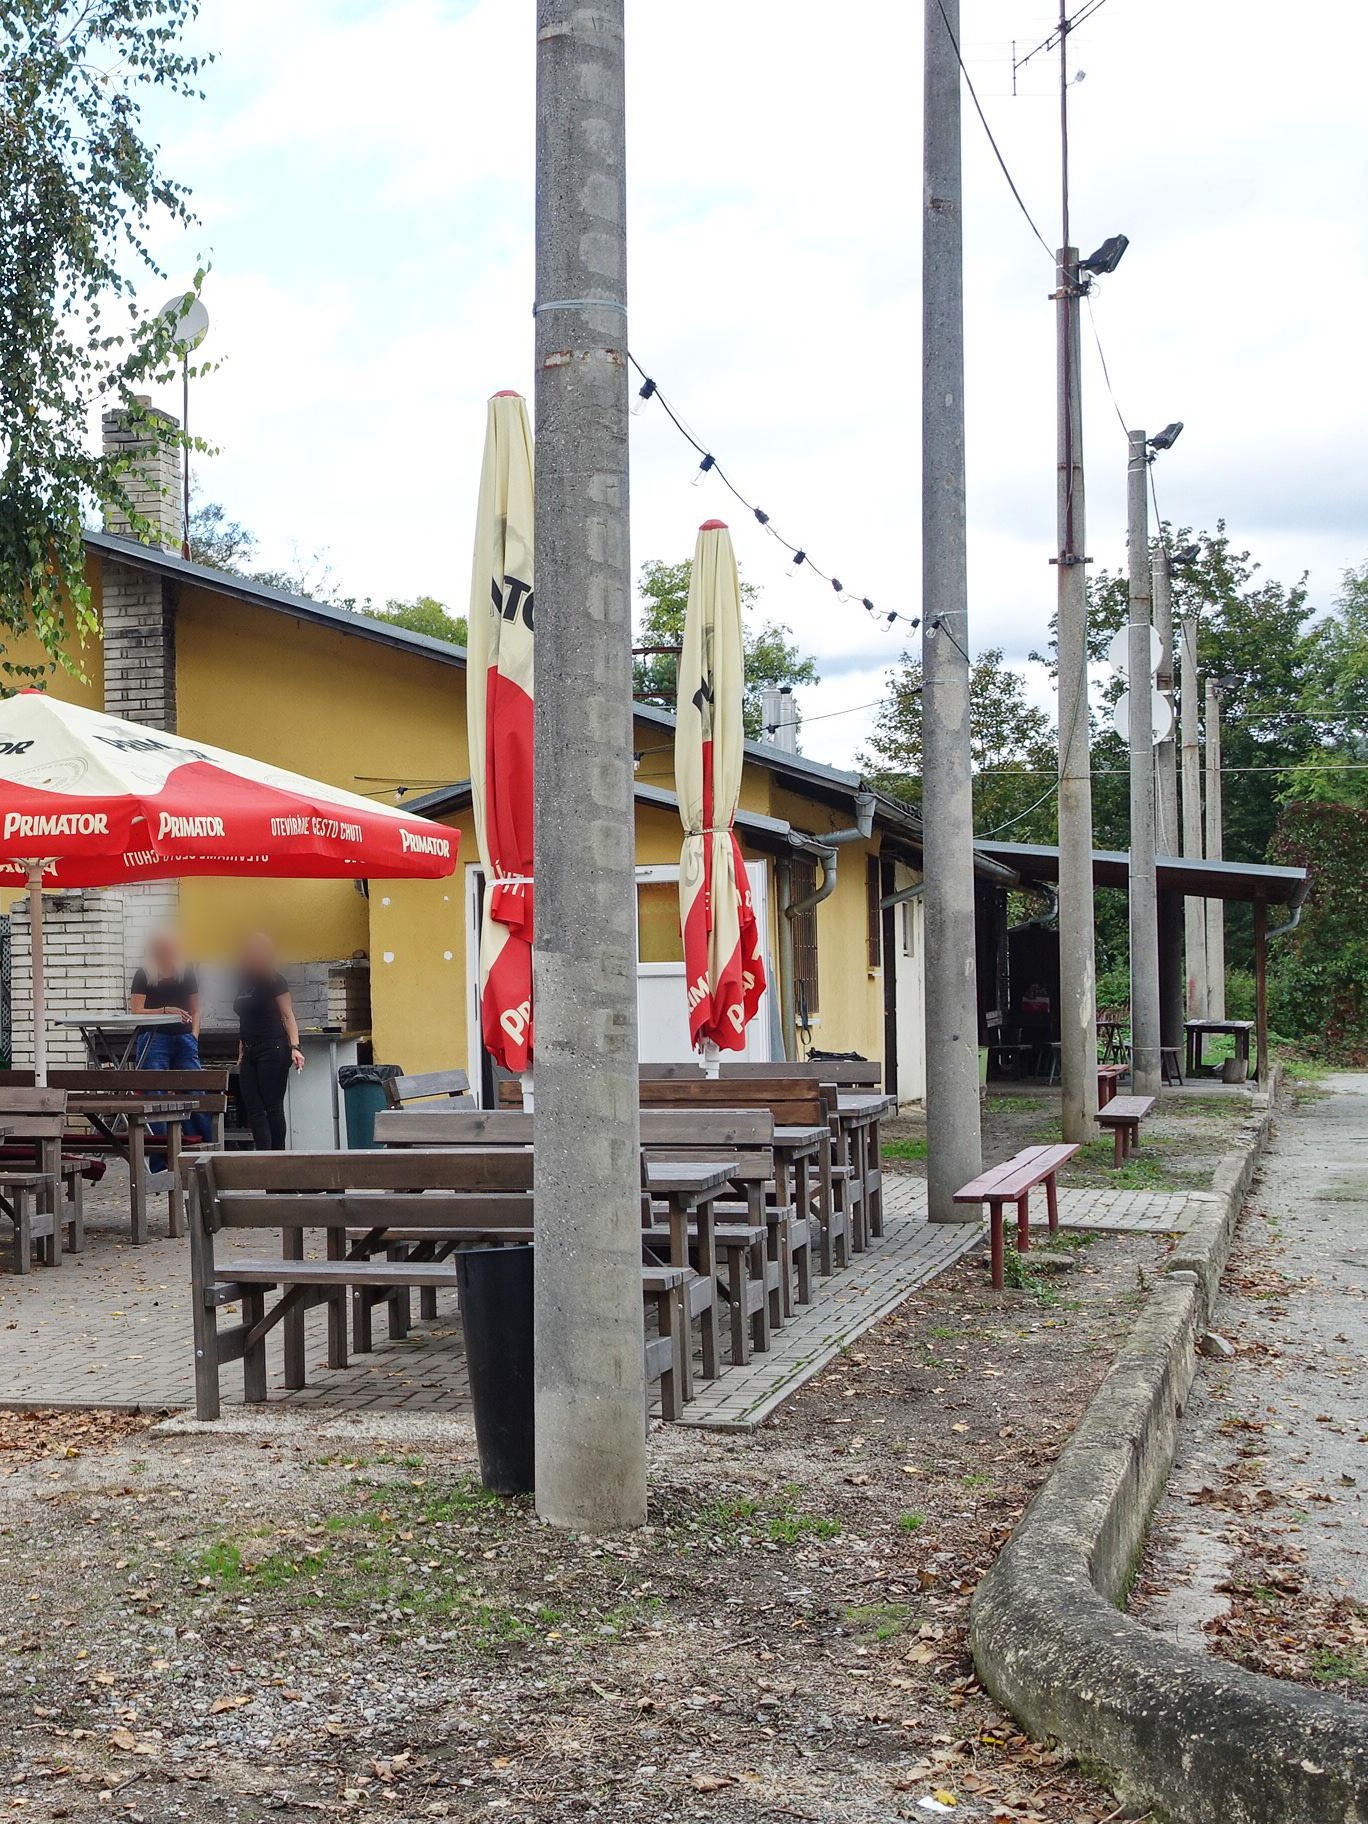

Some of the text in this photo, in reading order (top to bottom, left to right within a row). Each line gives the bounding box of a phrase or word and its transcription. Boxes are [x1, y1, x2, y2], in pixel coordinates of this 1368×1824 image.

[3, 812, 109, 840] PRIMATOR
[158, 811, 226, 840] PRIMATOR
[340, 822, 363, 843] CHUTI
[399, 828, 451, 858] PRIMATOR
